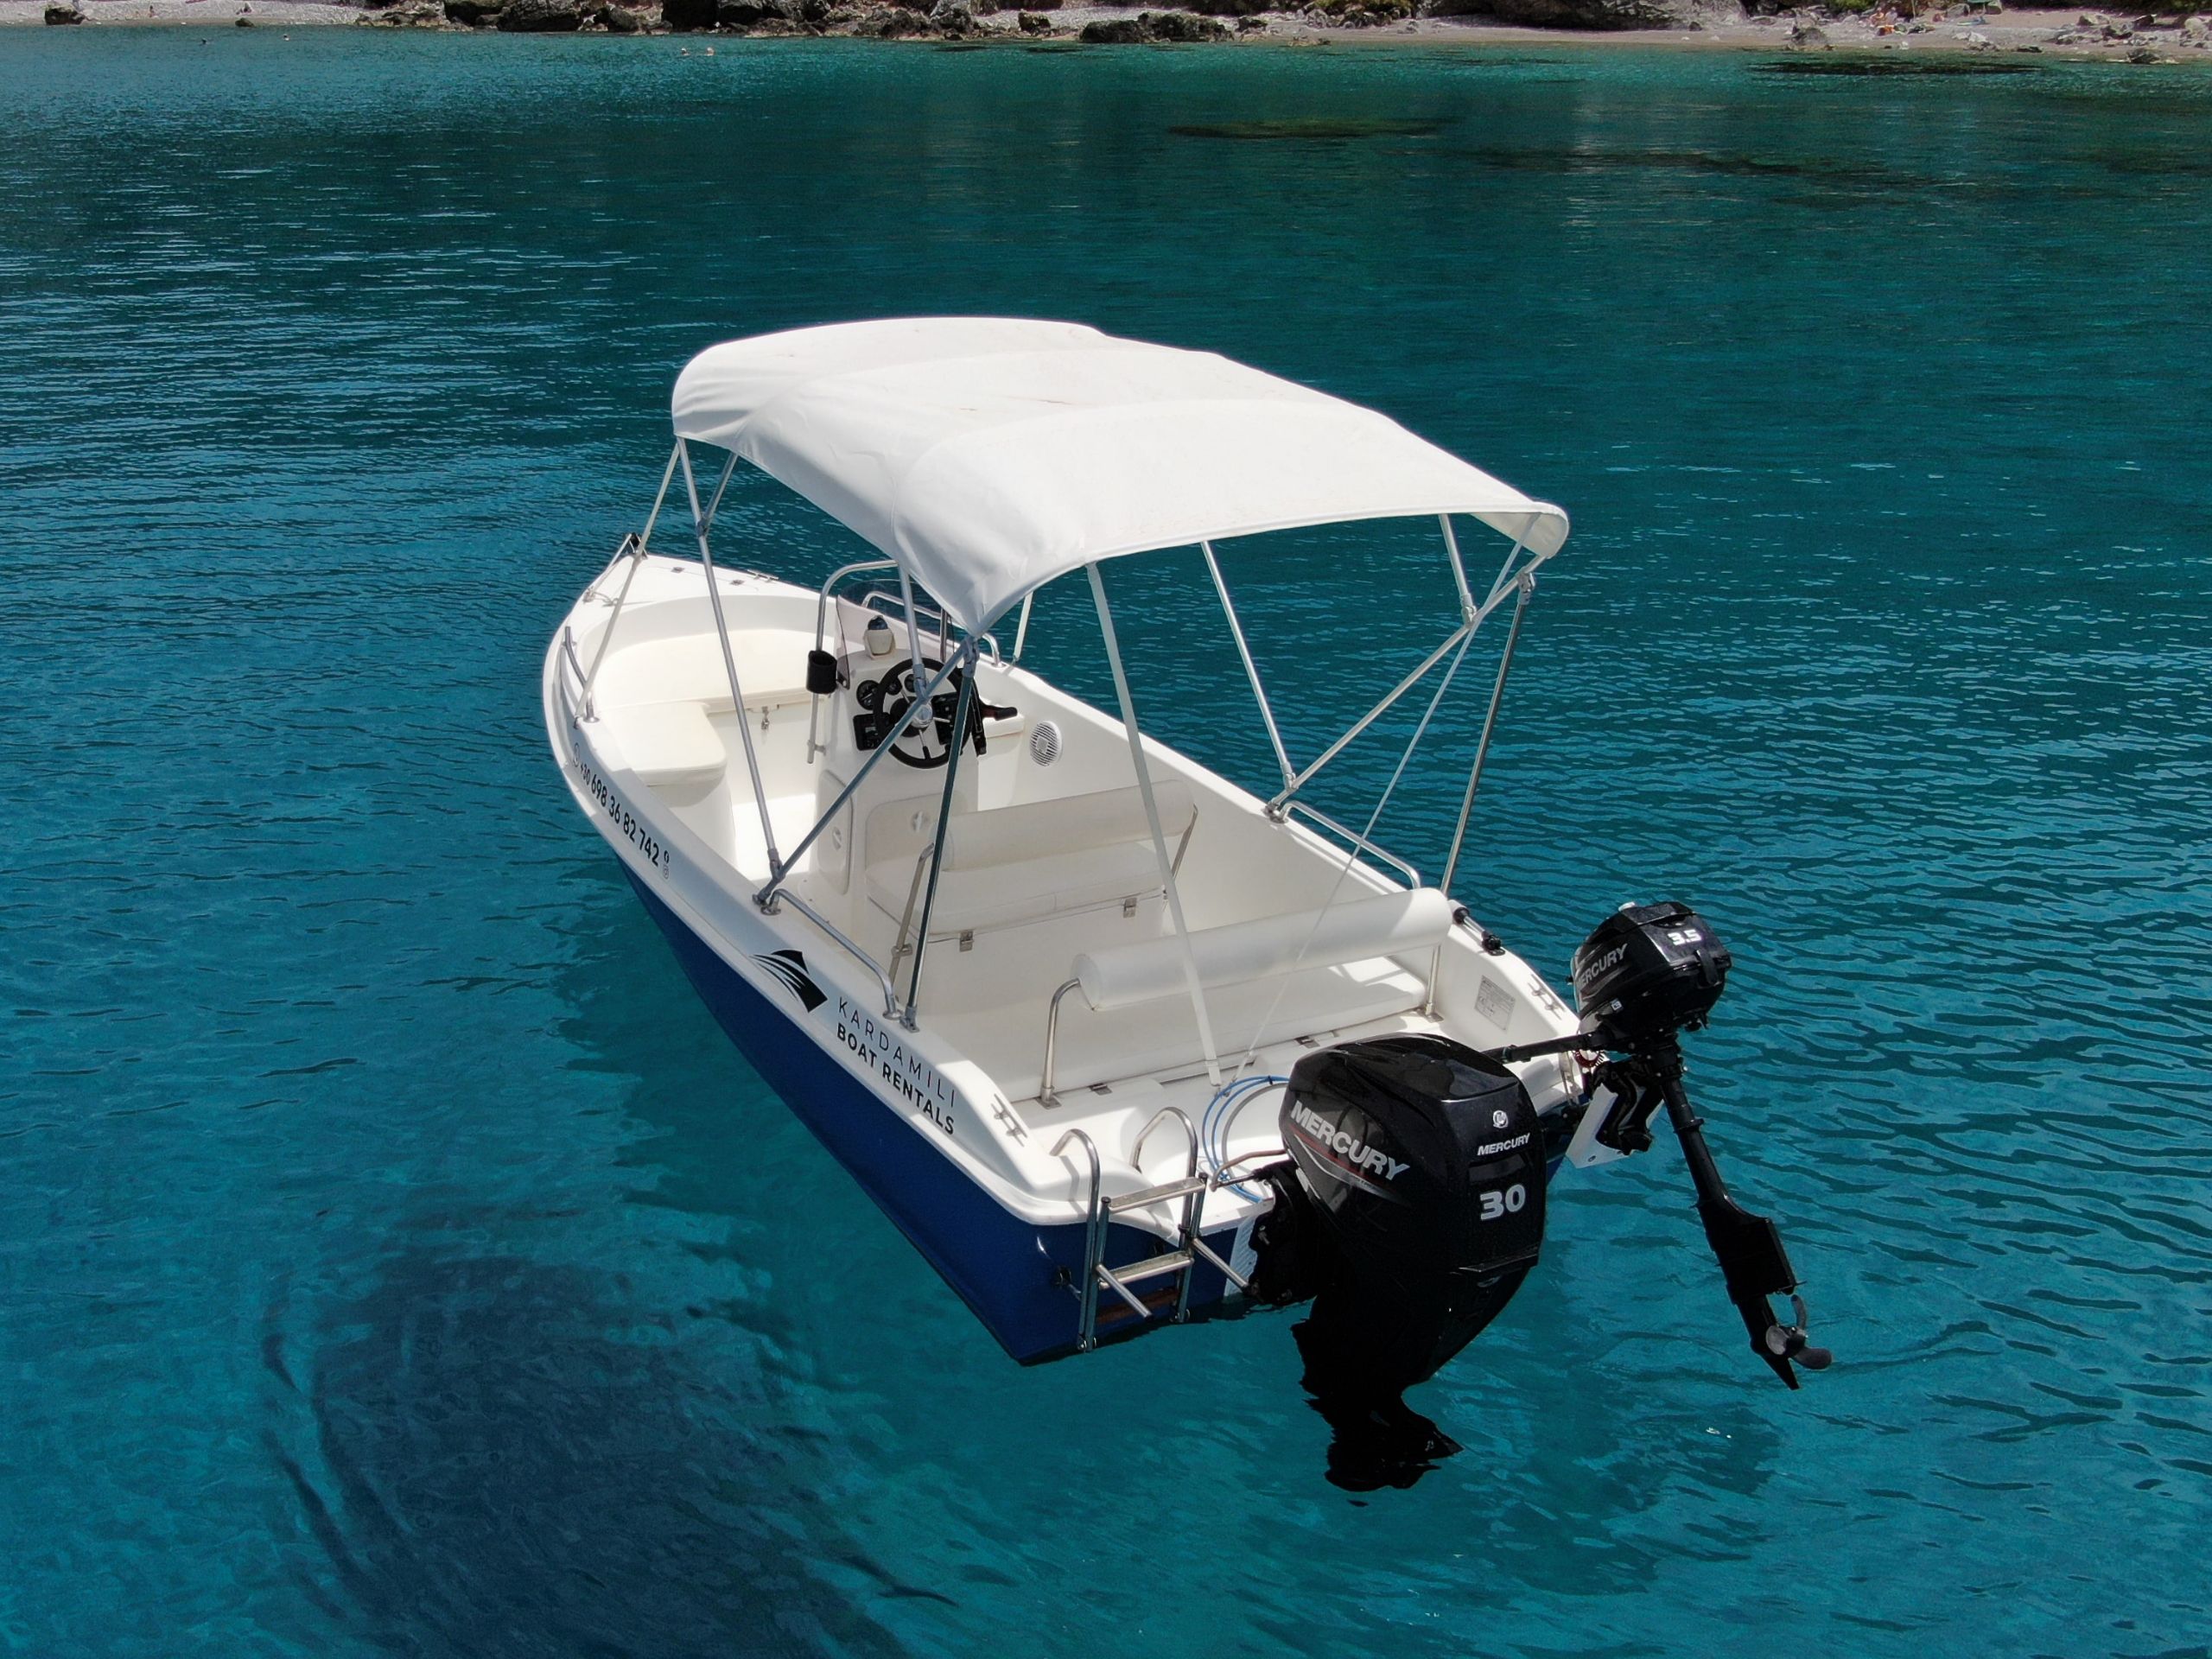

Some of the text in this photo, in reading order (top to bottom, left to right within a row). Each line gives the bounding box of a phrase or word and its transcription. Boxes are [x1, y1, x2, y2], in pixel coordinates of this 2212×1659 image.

[591, 773, 607, 807] 698
[608, 795, 620, 823] 36
[623, 812, 636, 842] 82
[639, 829, 659, 867] 742
[1668, 929, 1701, 946] 3.5
[837, 1022, 954, 1135] BOAT RENTALS
[838, 996, 955, 1108] KARDAMILI
[1290, 1101, 1410, 1180] MERCURY
[1477, 1132, 1530, 1156] MERCURY
[1479, 1184, 1525, 1221] 30
